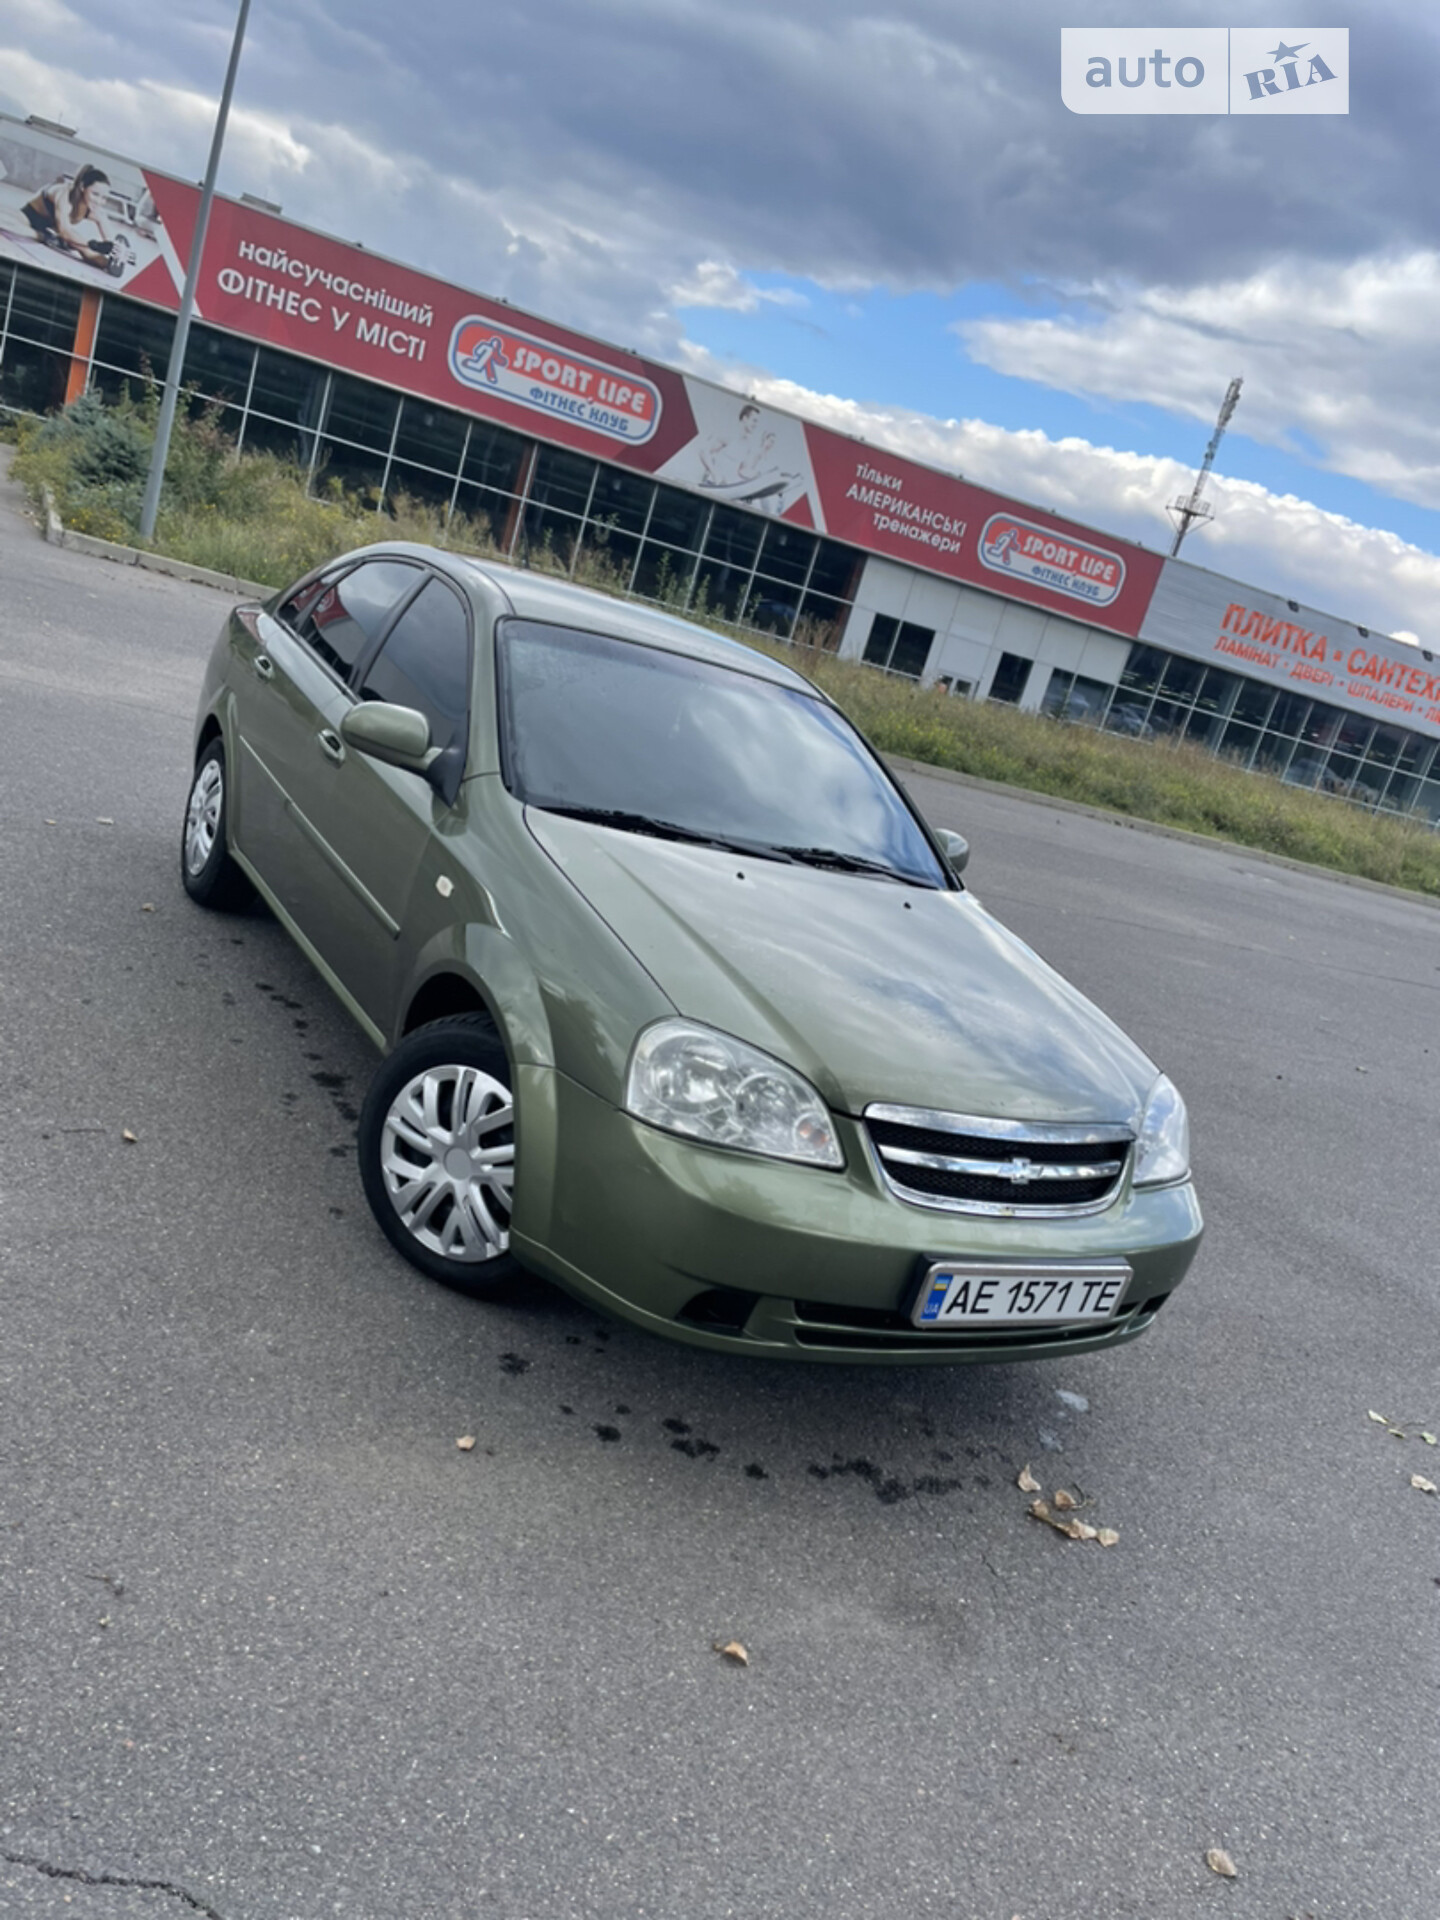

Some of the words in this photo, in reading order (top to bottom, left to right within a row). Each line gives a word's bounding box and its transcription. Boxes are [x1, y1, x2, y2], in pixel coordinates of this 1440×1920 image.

[238, 240, 434, 328] найсучасніший
[217, 268, 322, 323] ФІТНЕС
[330, 306, 350, 332] У
[355, 317, 426, 362] МІСТІ
[513, 347, 593, 393] SPORT
[597, 378, 647, 414] LIFE
[529, 387, 586, 417] ФІТНЕС
[588, 406, 629, 432] КЛУБ
[855, 462, 903, 492] тільки
[845, 482, 968, 538] АМЕРИКАНСЬКІ
[872, 512, 962, 554] тренажери
[1023, 535, 1079, 569] SPORT
[1220, 603, 1328, 663] ПЛИТКА
[1213, 636, 1281, 669] ЛАМІНАТ
[1287, 661, 1335, 687] ДВЕРІ
[1346, 679, 1416, 714] ШПАЛЕРИ
[945, 1280, 1000, 1315] AE
[1007, 1280, 1073, 1315] 1571
[1078, 1280, 1122, 1313] TE
